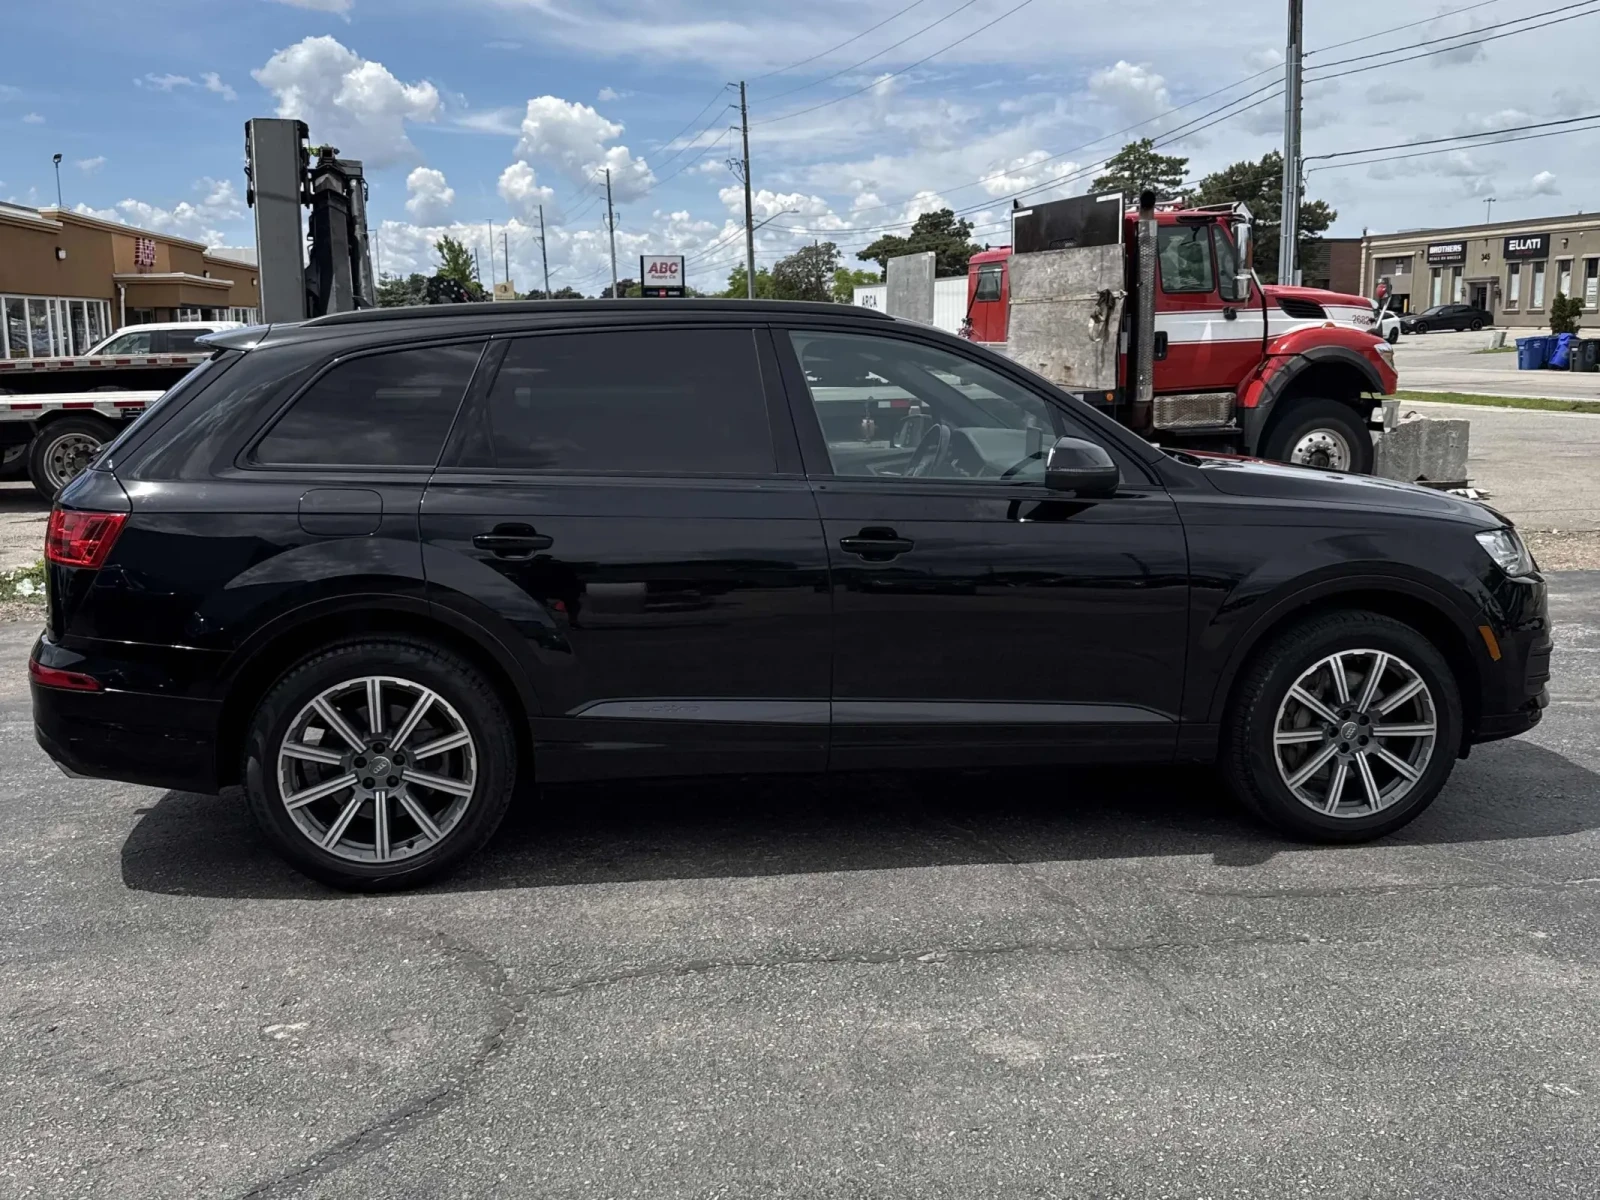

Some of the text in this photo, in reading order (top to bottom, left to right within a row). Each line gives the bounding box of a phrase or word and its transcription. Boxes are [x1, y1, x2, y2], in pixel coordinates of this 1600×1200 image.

[1429, 244, 1462, 254] BROTHERS
[1508, 238, 1541, 251] ELLATI
[1481, 253, 1491, 261] 345
[648, 262, 678, 274] ABC
[862, 295, 877, 308] ARCA
